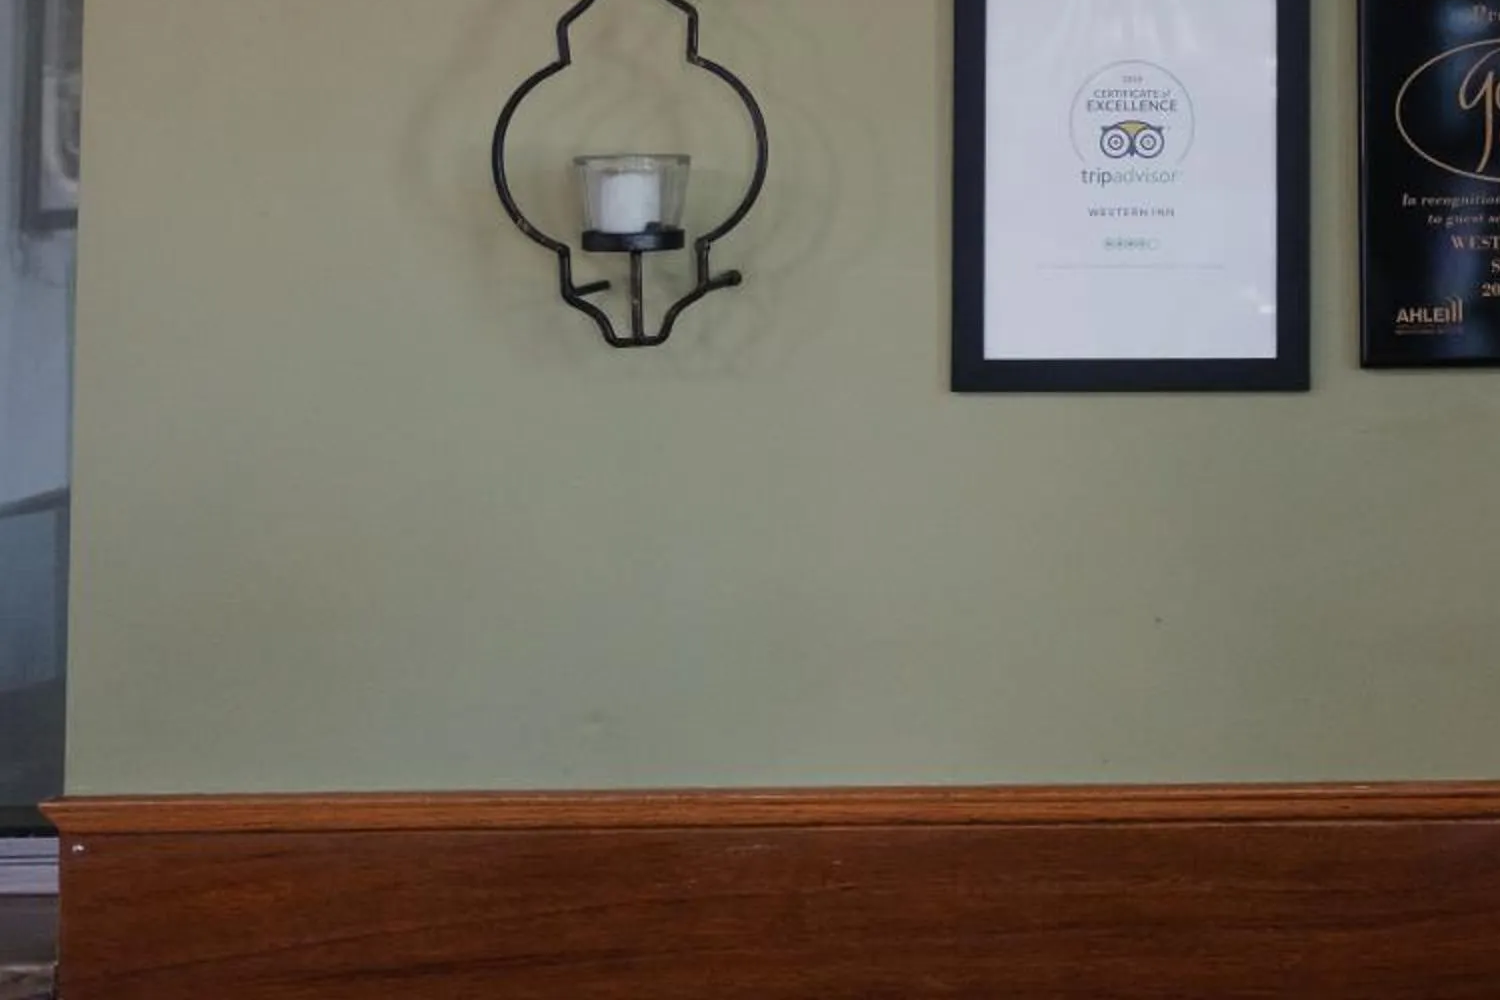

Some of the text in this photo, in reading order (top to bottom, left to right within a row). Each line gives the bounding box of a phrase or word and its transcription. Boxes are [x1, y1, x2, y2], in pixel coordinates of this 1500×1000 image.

[1093, 88, 1159, 99] CERTIFICATE
[1086, 99, 1178, 112] EXCELLENCE
[1081, 167, 1176, 188] tripadvisor
[1402, 193, 1417, 207] In
[1087, 206, 1175, 217] WESTERN INN
[1427, 214, 1442, 225] to
[1446, 214, 1483, 228] guest
